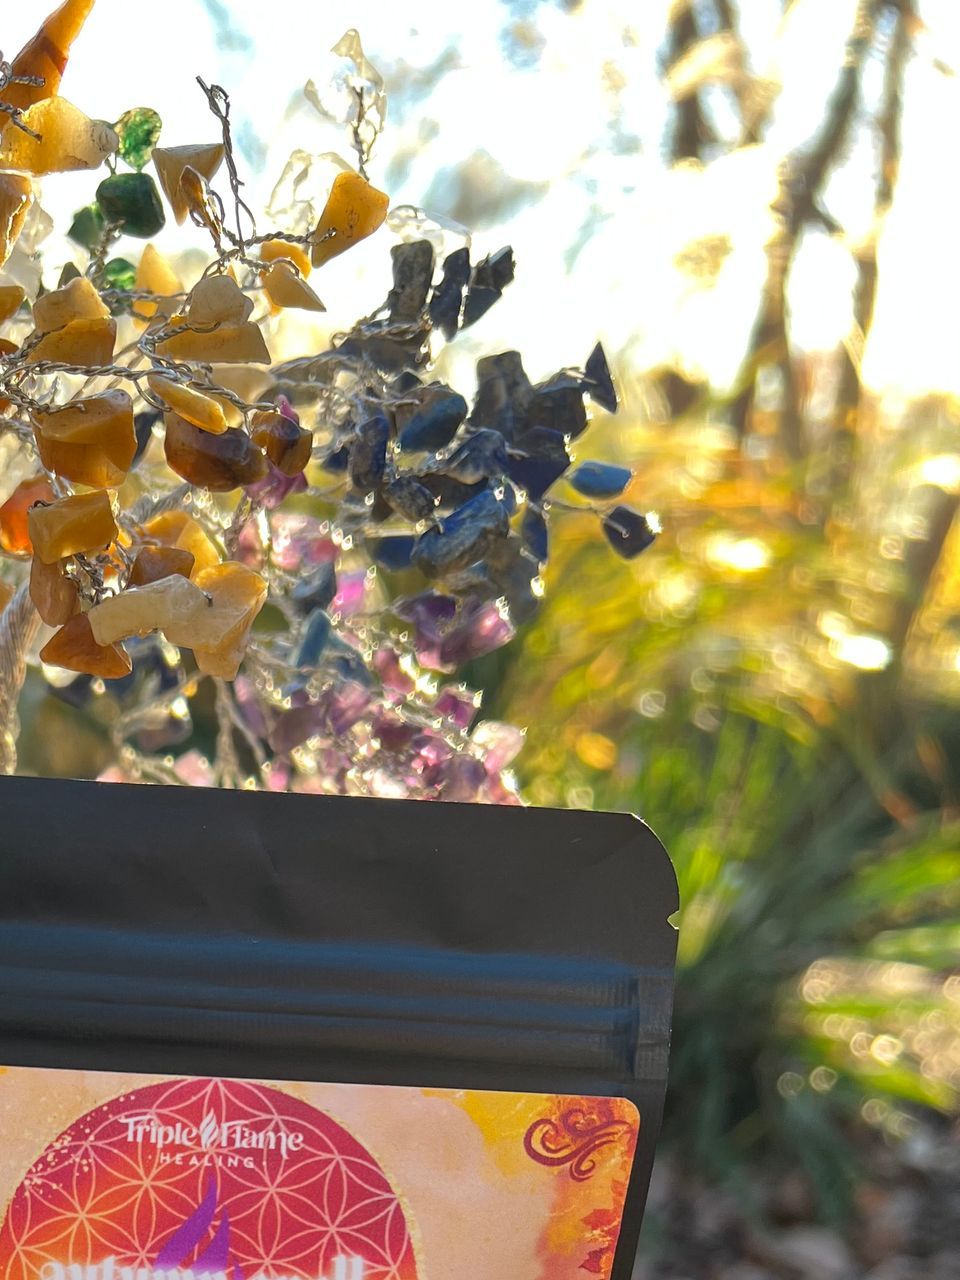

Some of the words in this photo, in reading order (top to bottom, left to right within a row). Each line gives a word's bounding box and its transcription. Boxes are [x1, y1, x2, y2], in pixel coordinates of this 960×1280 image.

[119, 1114, 199, 1148] Triple
[221, 1119, 304, 1159] Flame
[160, 1152, 255, 1168] HEALING
